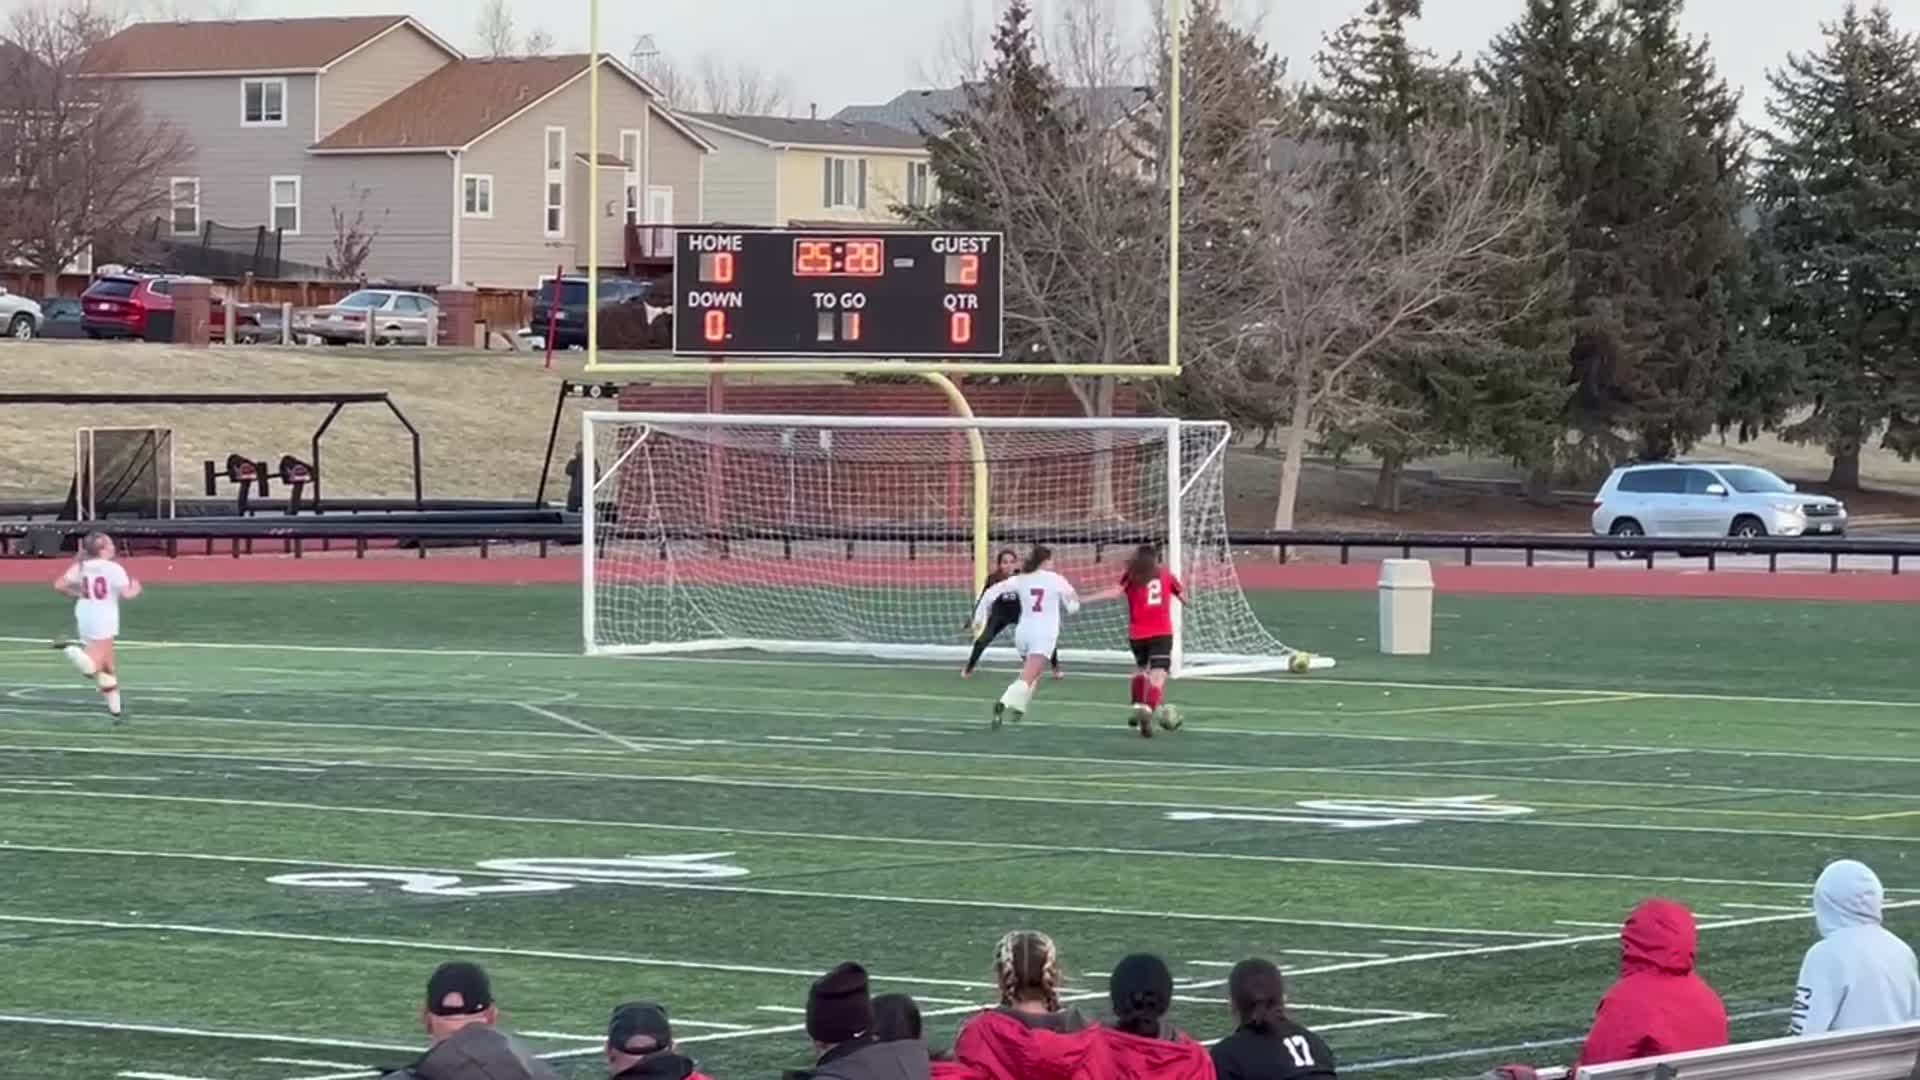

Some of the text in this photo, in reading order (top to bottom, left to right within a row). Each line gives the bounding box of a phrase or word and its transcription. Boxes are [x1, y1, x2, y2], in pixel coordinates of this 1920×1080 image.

[688, 235, 743, 251] HOME
[931, 236, 991, 253] GUEST
[714, 252, 733, 283] 0
[797, 242, 879, 272] 25:28
[959, 254, 979, 285] 2
[687, 291, 743, 307] DOWN
[813, 292, 866, 308] TO GO
[943, 294, 979, 312] QTR
[951, 312, 971, 343] 0
[81, 575, 107, 600] 10
[1148, 578, 1162, 605] 2
[1030, 588, 1045, 613] 7
[1282, 1034, 1316, 1067] 17
